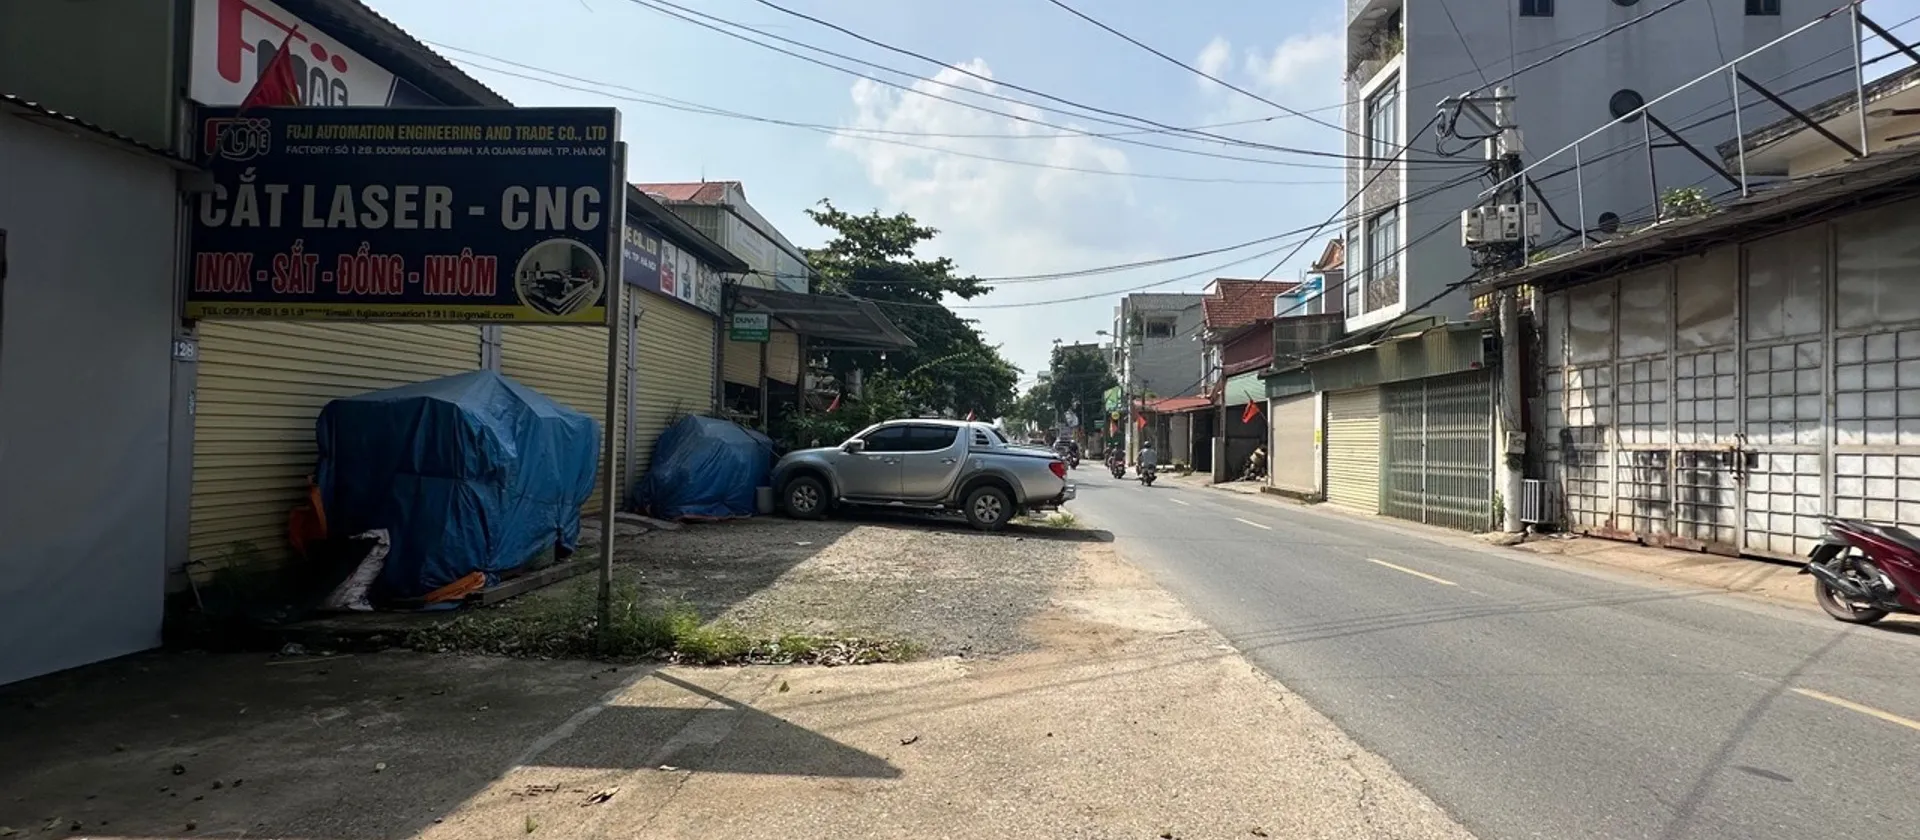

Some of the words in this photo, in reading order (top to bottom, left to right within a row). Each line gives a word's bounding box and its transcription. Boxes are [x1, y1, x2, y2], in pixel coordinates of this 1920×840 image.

[286, 124, 313, 139] FUJI
[316, 124, 394, 140] AUTOMATION
[398, 125, 481, 140] ENGINEERING
[485, 125, 512, 140] AND
[515, 126, 554, 140] TRADE
[558, 126, 582, 141] CO.,
[585, 126, 607, 140] LTD
[286, 145, 333, 155] FACTORY:
[412, 146, 447, 156] QUANG
[491, 146, 526, 156] QUANG
[556, 146, 572, 156] TP.
[200, 167, 289, 228] CẮT
[302, 184, 453, 229] LASER
[468, 206, 485, 216] -
[501, 185, 600, 231] CNC
[195, 252, 252, 293] INOX
[256, 270, 268, 281] -
[271, 238, 319, 294] SẮT
[322, 271, 333, 282] -
[336, 241, 404, 294] ĐỒNG
[408, 272, 420, 283] -
[424, 247, 498, 296] NHÔM
[201, 306, 221, 315] TEL:
[174, 341, 194, 357] 128
